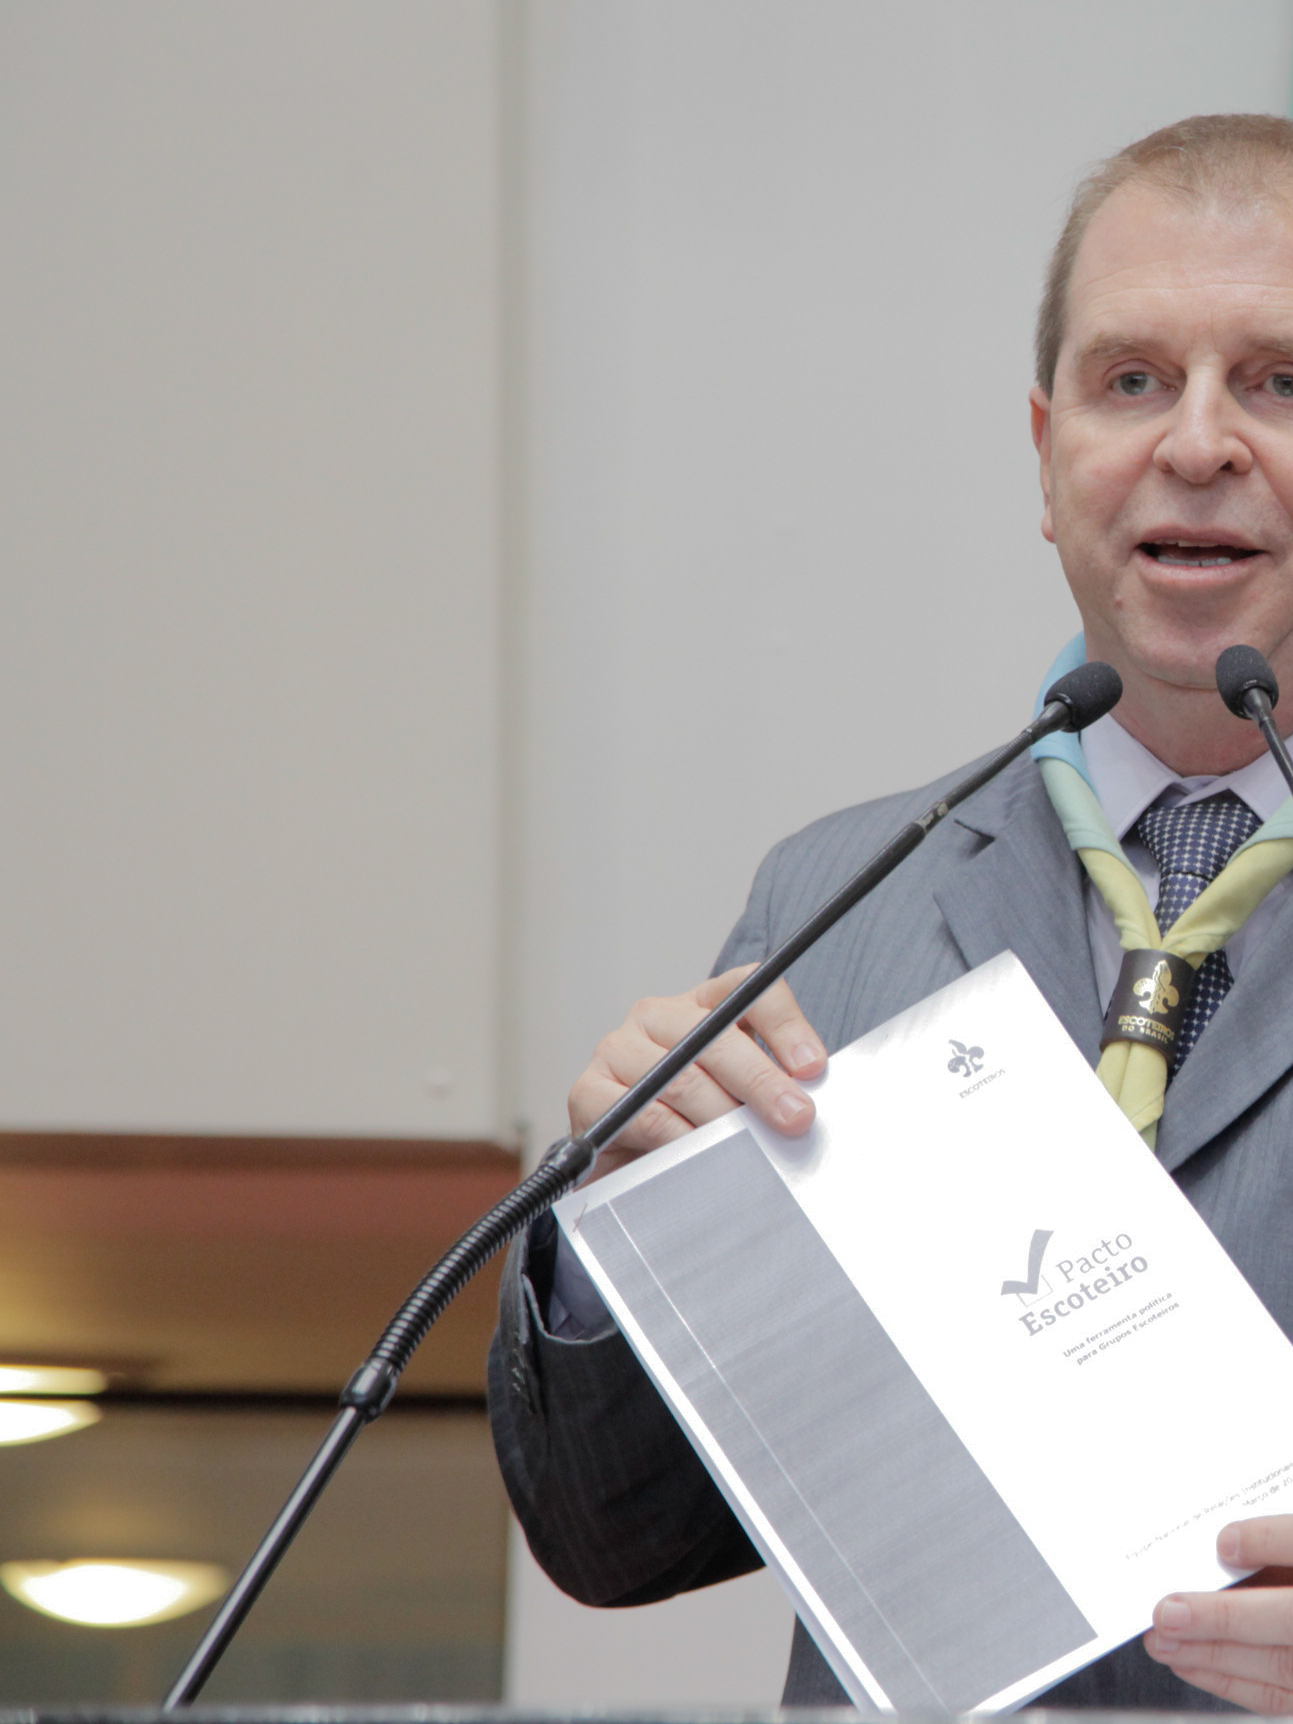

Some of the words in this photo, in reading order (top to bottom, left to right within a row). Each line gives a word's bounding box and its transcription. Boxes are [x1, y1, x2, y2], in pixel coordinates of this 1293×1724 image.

[1118, 1015, 1175, 1041] ESCOTEIROS
[1122, 1025, 1135, 1033] DO
[1140, 1027, 1169, 1044] BRASIL
[957, 1067, 1006, 1099] ESCOTEIROS
[1055, 1233, 1133, 1283] Pacto
[1018, 1256, 1149, 1337] Escoteiro
[1063, 1342, 1086, 1358] Uma
[1085, 1312, 1137, 1344] ferramenta
[1076, 1349, 1098, 1366] para
[1098, 1329, 1132, 1351] Grupos
[1132, 1302, 1180, 1332] Escoteiros
